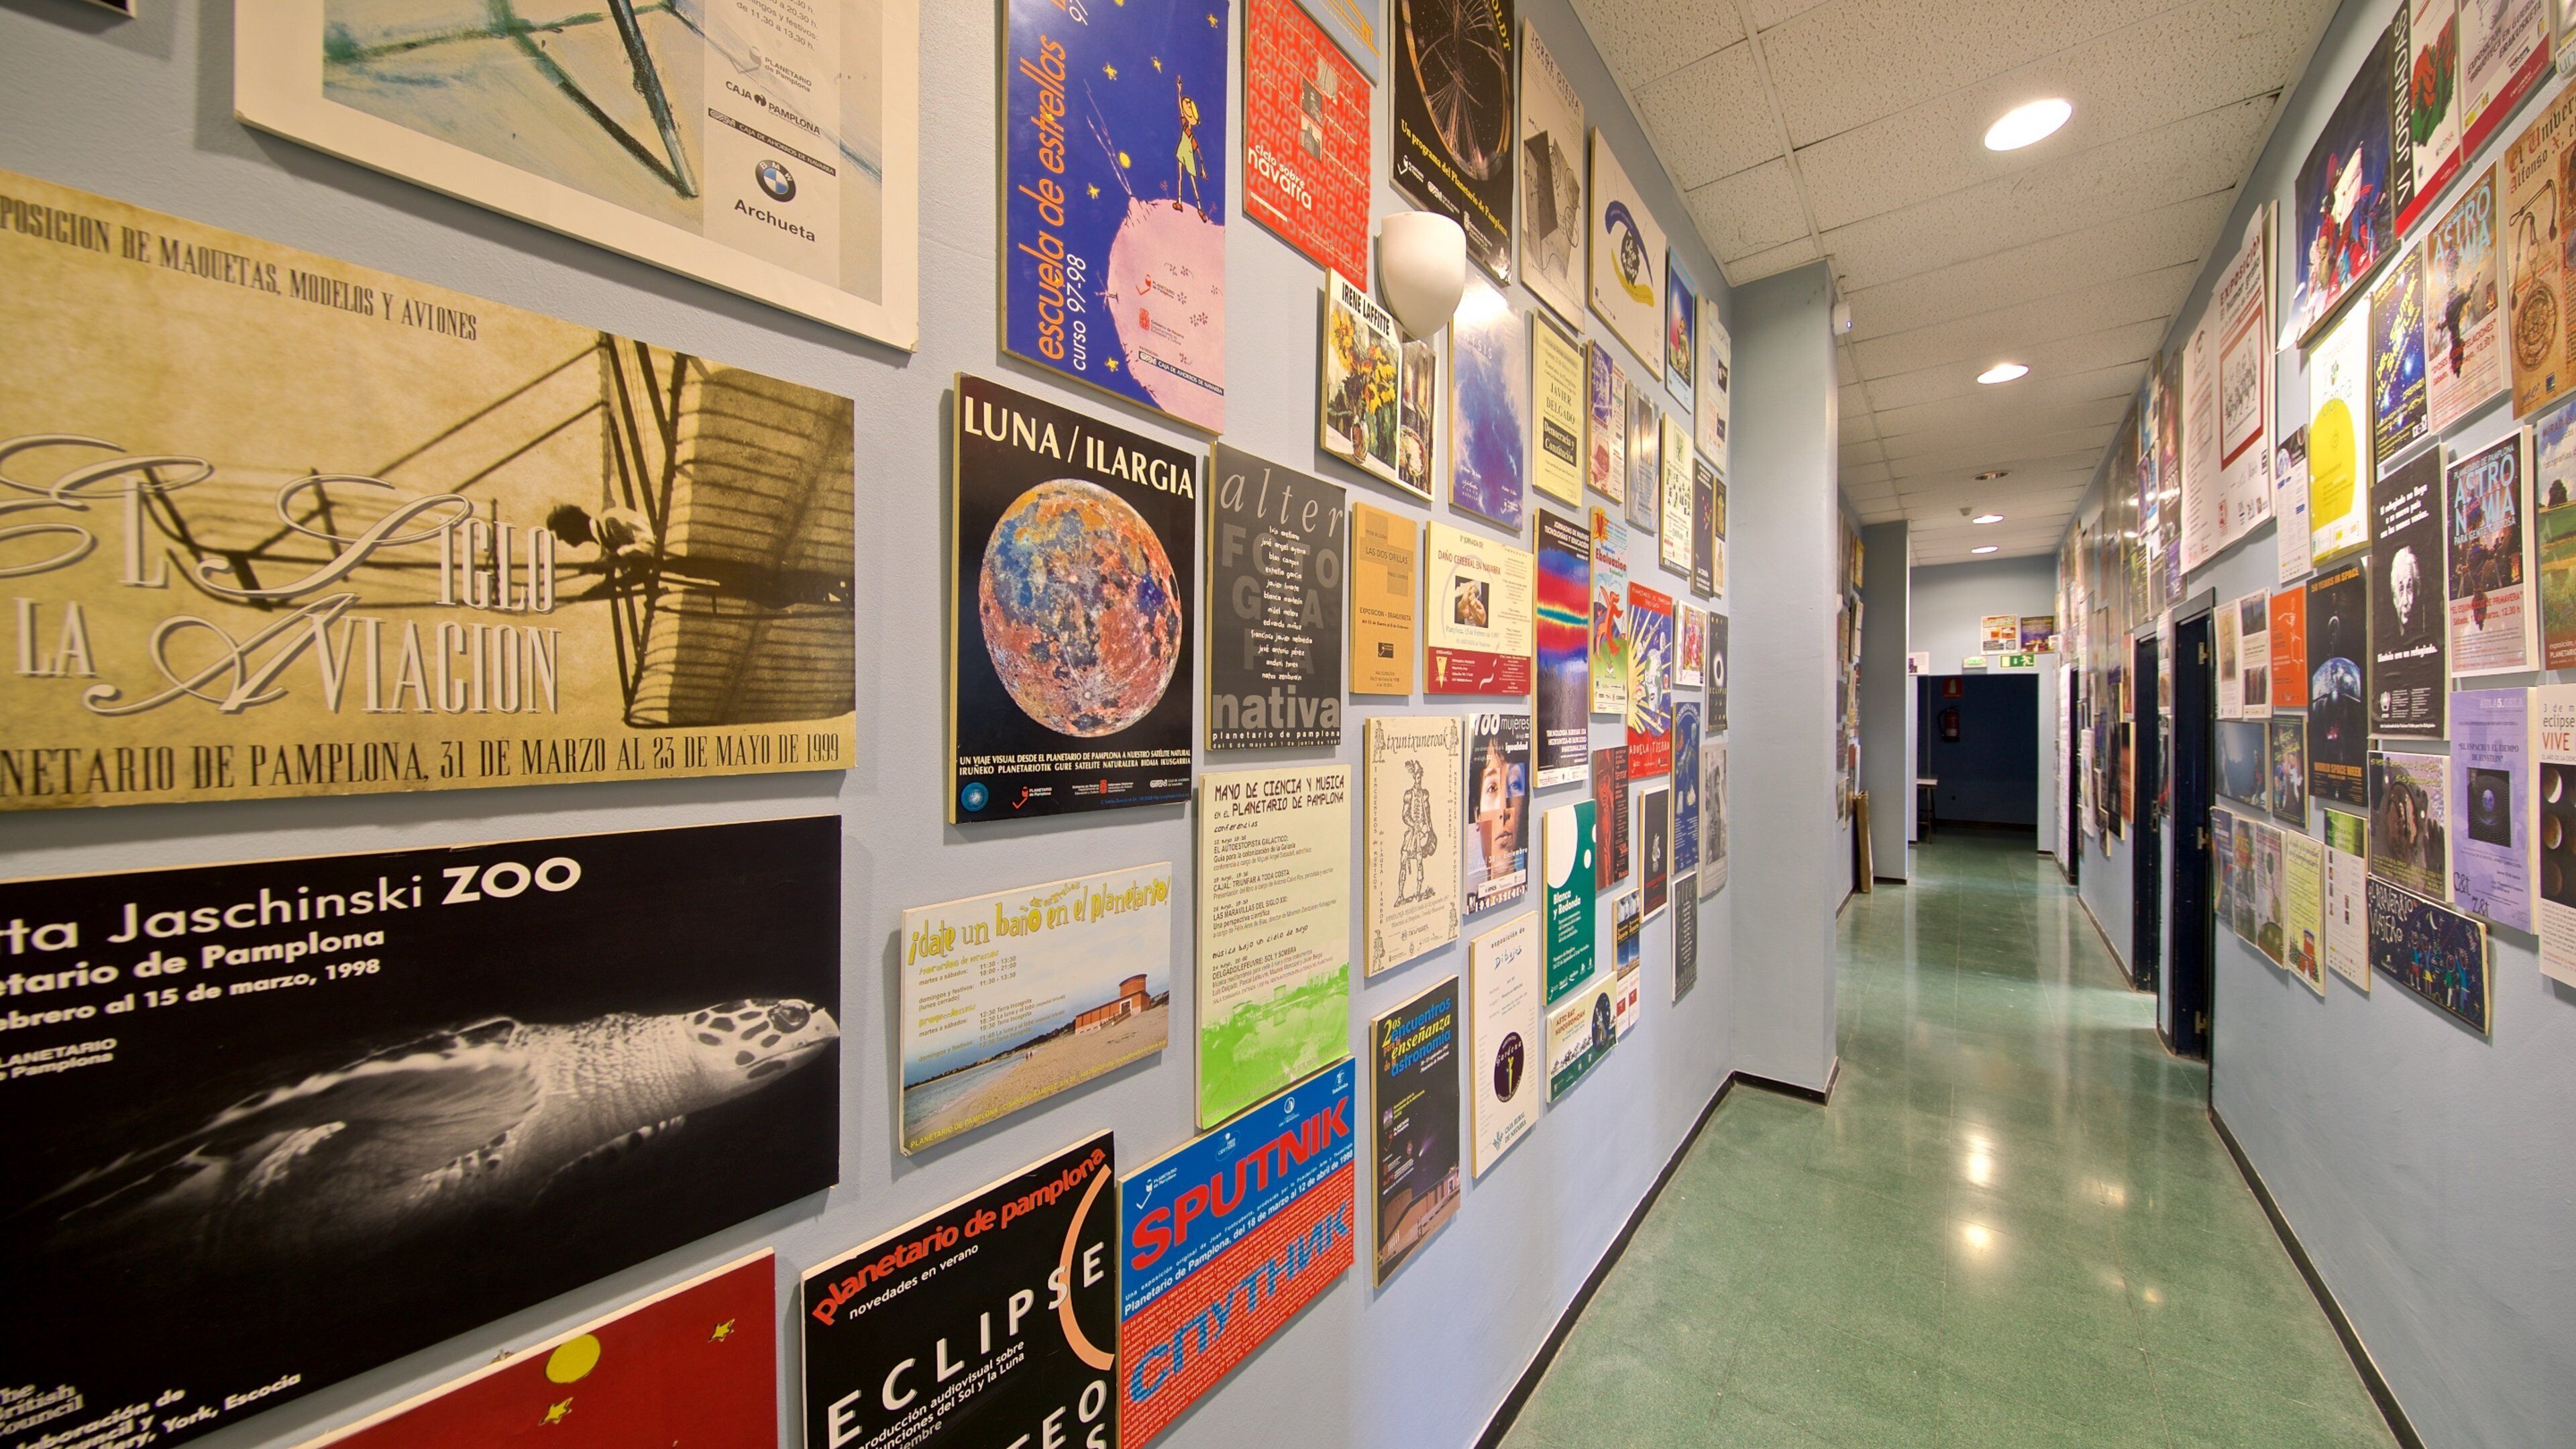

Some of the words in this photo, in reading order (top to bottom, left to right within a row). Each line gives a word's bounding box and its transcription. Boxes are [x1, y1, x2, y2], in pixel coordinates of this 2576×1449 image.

[765, 56, 812, 87] PLANETARIO
[775, 70, 811, 93] Pamplona
[1532, 32, 1554, 72] JORGE
[1557, 72, 1579, 107] OTEIZA
[2394, 8, 2410, 163] JORNADAS
[726, 80, 752, 101] CAJA
[769, 102, 821, 136] PAMPLONA
[1020, 35, 1065, 174] estrellas
[739, 125, 756, 136] CAJA
[767, 137, 798, 156] AHORROS
[807, 157, 834, 174] NAVARRA
[1255, 144, 1277, 166] ciclo
[1279, 163, 1305, 189] sobre
[2509, 146, 2524, 174] El
[2510, 149, 2548, 194] Alfonso
[1248, 147, 1312, 211] navarra
[1401, 119, 1411, 138] Un
[1412, 133, 1441, 168] programa
[1442, 162, 1451, 178] del
[1452, 170, 1478, 205] Planetario
[1485, 207, 1507, 237] Pamplona
[734, 199, 815, 243] Archueta
[1018, 178, 1065, 227] de
[121, 225, 151, 265] DE
[159, 235, 282, 296] MAQUETAS,
[289, 268, 374, 317] MODELOS
[382, 291, 396, 321] Y
[401, 299, 478, 341] AVIONES
[1018, 231, 1065, 360] escuela
[1067, 254, 1086, 314] 97-98
[1342, 282, 1361, 315] IRENE
[1363, 299, 1390, 336] LAFFITTE
[1073, 320, 1086, 371] curso
[1546, 397, 1575, 425] DELGADO
[1550, 382, 1572, 407] JAVIER
[965, 395, 1061, 460] LUNA
[1086, 435, 1194, 500] ILARGIA
[1544, 421, 1571, 447] Democracia
[1545, 437, 1574, 463] Constitución
[1220, 468, 1344, 537] alter
[2455, 453, 2514, 508] ASTRO
[1222, 523, 1340, 589] FOTO
[1366, 547, 1375, 556] LAS
[1377, 549, 1388, 559] DOS
[1389, 551, 1407, 565] ORILLAS
[1438, 549, 1452, 562] DAÑO
[1454, 553, 1475, 569] CEREBRAL
[1483, 561, 1501, 576] NAVARRA
[1595, 547, 1627, 572] Ebaluazioa
[2341, 567, 2359, 581] SPACE
[13, 597, 97, 678] LA
[84, 592, 562, 716] AVIACION
[1212, 684, 1341, 730] nativa
[1474, 714, 1500, 735] 100
[1501, 715, 1529, 735] mujeres
[2543, 714, 2575, 731] eclipse
[973, 755, 991, 765] VIAJE
[992, 755, 1016, 764] VISUAL
[1017, 754, 1037, 763] DESDE
[1046, 752, 1081, 761] PLANETARIO
[1091, 751, 1121, 759] PAMPLONA
[1212, 731, 1274, 741] planetario
[1296, 730, 1340, 739] pamplona
[1387, 727, 1449, 754] txuntxuneroak
[1505, 741, 1528, 753] igualdad
[1629, 743, 1650, 755] ABUELA
[1652, 741, 1670, 754] TIERRA
[2542, 733, 2570, 751] VIVE
[195, 745, 235, 789] DE
[249, 740, 429, 786] PAMPLONA,
[439, 739, 466, 779] 31
[479, 739, 511, 775] DE
[521, 737, 605, 776] MARZO
[617, 736, 645, 771] AL
[653, 735, 674, 769] 23
[684, 735, 708, 767] DE
[714, 734, 770, 767] MAYO
[777, 733, 800, 764] DE
[805, 733, 839, 763] 1999
[959, 764, 994, 775] IRUÑEKO
[998, 763, 1052, 773] PLANETARIOTIK
[1215, 783, 1240, 802] MAYO
[1264, 779, 1301, 797] CIENCIA
[1316, 775, 1344, 790] MUSICA
[1232, 797, 1287, 816] PLANETARIO
[1307, 792, 1344, 808] PAMPLONA
[1214, 821, 1258, 833] conferencias
[107, 875, 421, 945] Jaschinski
[442, 857, 582, 905] ZOO
[1554, 890, 1571, 905] Blanca
[1558, 895, 1581, 915] Redonda
[908, 918, 956, 966] ¡date
[961, 920, 990, 947] un
[995, 902, 1042, 937] baño
[1073, 886, 1088, 922] el
[1090, 875, 1172, 924] planetario!
[1491, 931, 1517, 949] exposición
[133, 951, 188, 978] de
[202, 927, 385, 971] Pamplona
[1495, 945, 1522, 970] Dibujos
[104, 993, 135, 1014] al
[144, 987, 180, 1008] 15
[186, 982, 221, 1003] de
[229, 969, 317, 996] marzo,
[325, 958, 380, 980] 1998
[1391, 998, 1450, 1042] encuentros
[1391, 1014, 1451, 1059] enseñanza
[11, 1053, 114, 1079] Pamplona
[910, 1126, 953, 1148] PLANETARIO
[1131, 1096, 1350, 1271] SPUTNIK
[812, 1226, 959, 1327] planetario
[964, 1209, 996, 1238] de
[1001, 1148, 1106, 1230] pamplona
[1124, 1276, 1173, 1316] Planetario
[1188, 1238, 1232, 1273] Pamplona,
[1233, 1227, 1246, 1240] del
[1268, 1195, 1289, 1214] marzo
[849, 1275, 918, 1320] novedades
[920, 1266, 936, 1281] en
[939, 1244, 979, 1271] verano
[1130, 1201, 1350, 1403] СПУТНИК
[828, 1241, 1105, 1449] ECLIPSE
[155, 1389, 186, 1407] de
[930, 1361, 994, 1410] audiovisual
[996, 1341, 1024, 1366] sobre
[936, 1401, 955, 1417] del
[958, 1386, 975, 1403] Sol
[1000, 1352, 1025, 1376] Luna
[161, 1404, 219, 1434] York,
[224, 1373, 301, 1411] Escocia
